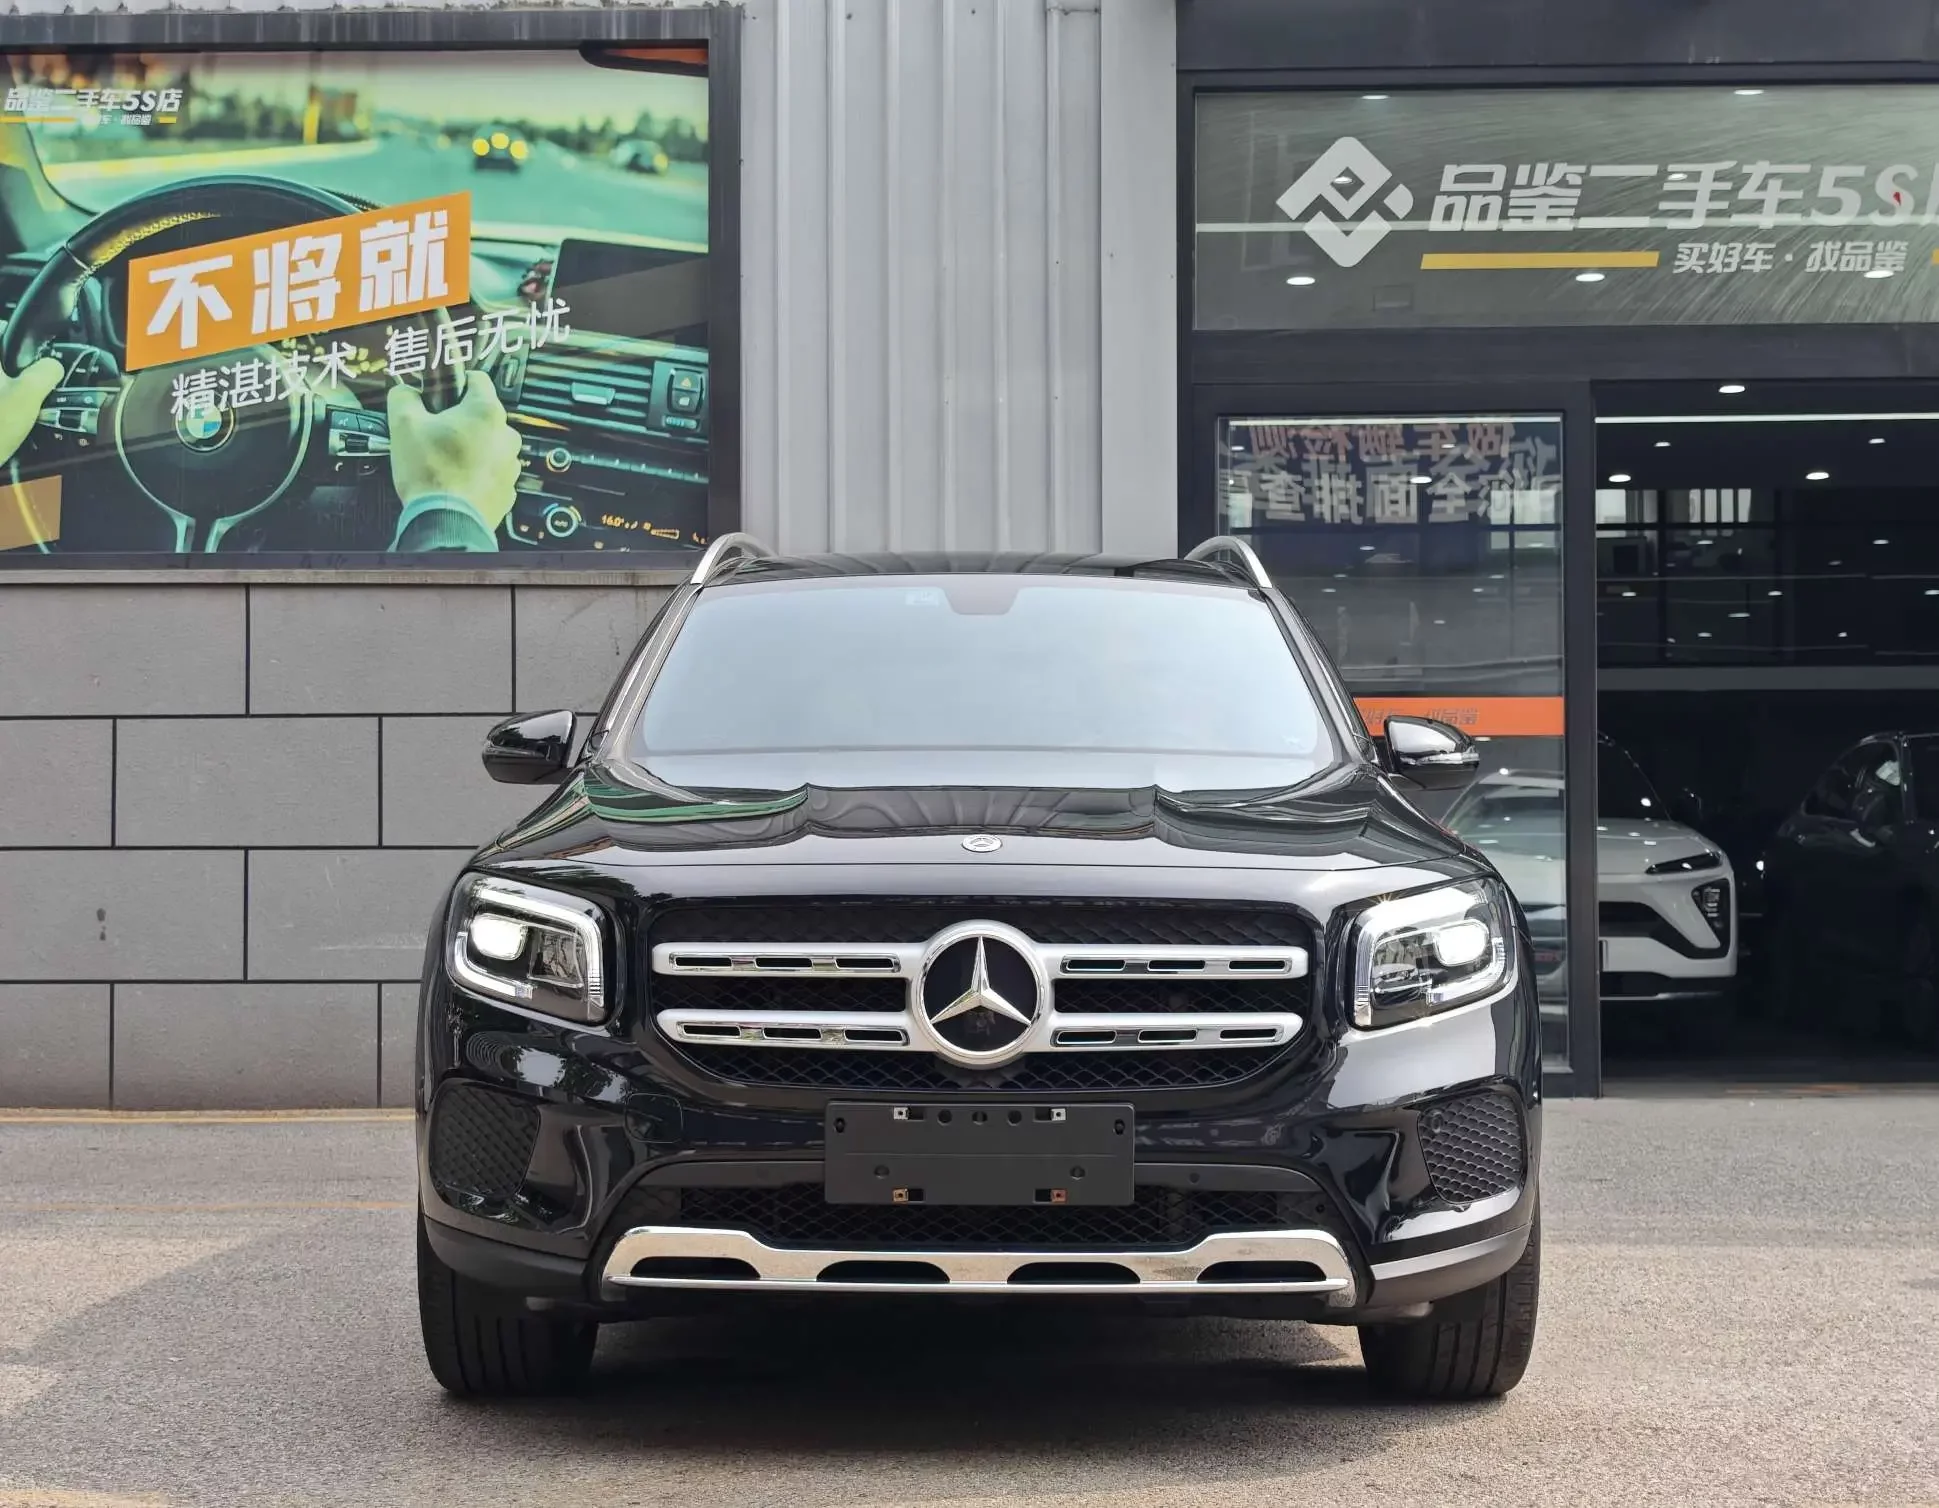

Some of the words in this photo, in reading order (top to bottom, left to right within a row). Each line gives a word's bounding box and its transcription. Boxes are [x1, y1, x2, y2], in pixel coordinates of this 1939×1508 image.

[4, 87, 183, 113] 品鉴二手车5S店
[1429, 161, 1939, 233] 品鉴二手车5S
[145, 209, 449, 350] 不将就
[170, 341, 358, 421] 精湛技术
[384, 297, 571, 377] 售后无忧
